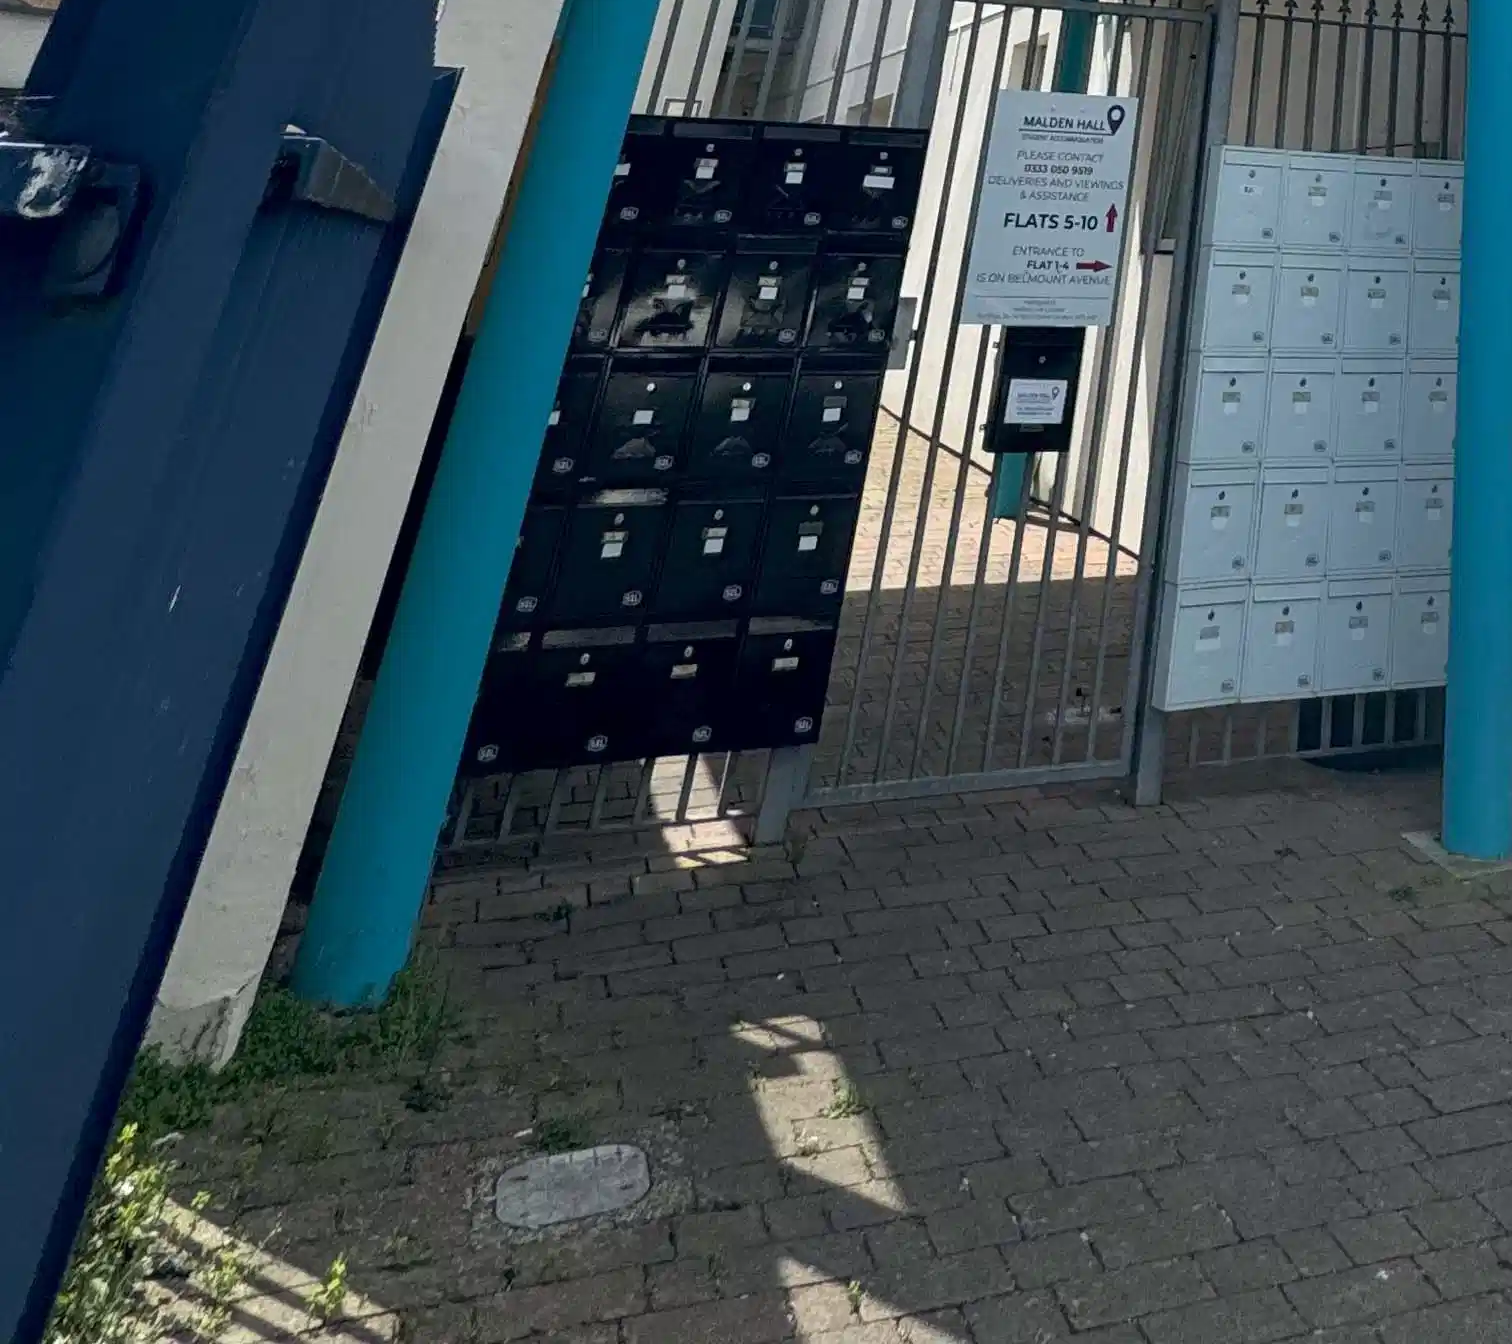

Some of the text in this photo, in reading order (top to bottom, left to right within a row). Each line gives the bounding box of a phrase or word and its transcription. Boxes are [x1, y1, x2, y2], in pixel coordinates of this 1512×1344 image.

[1023, 116, 1106, 131] MALDEN HALL
[1016, 150, 1104, 164] PLEASE CONTACT
[988, 175, 1125, 190] DELIVERIES AND VIEWINGS
[1028, 192, 1089, 202] ASSISTANCE
[1003, 212, 1099, 230] FLATS 5-10
[1012, 246, 1085, 257] ENTRANCE TO
[1026, 260, 1053, 270] FLAT
[976, 273, 986, 283] IS
[987, 273, 1005, 284] ON
[1069, 275, 1111, 286] AVENUE
